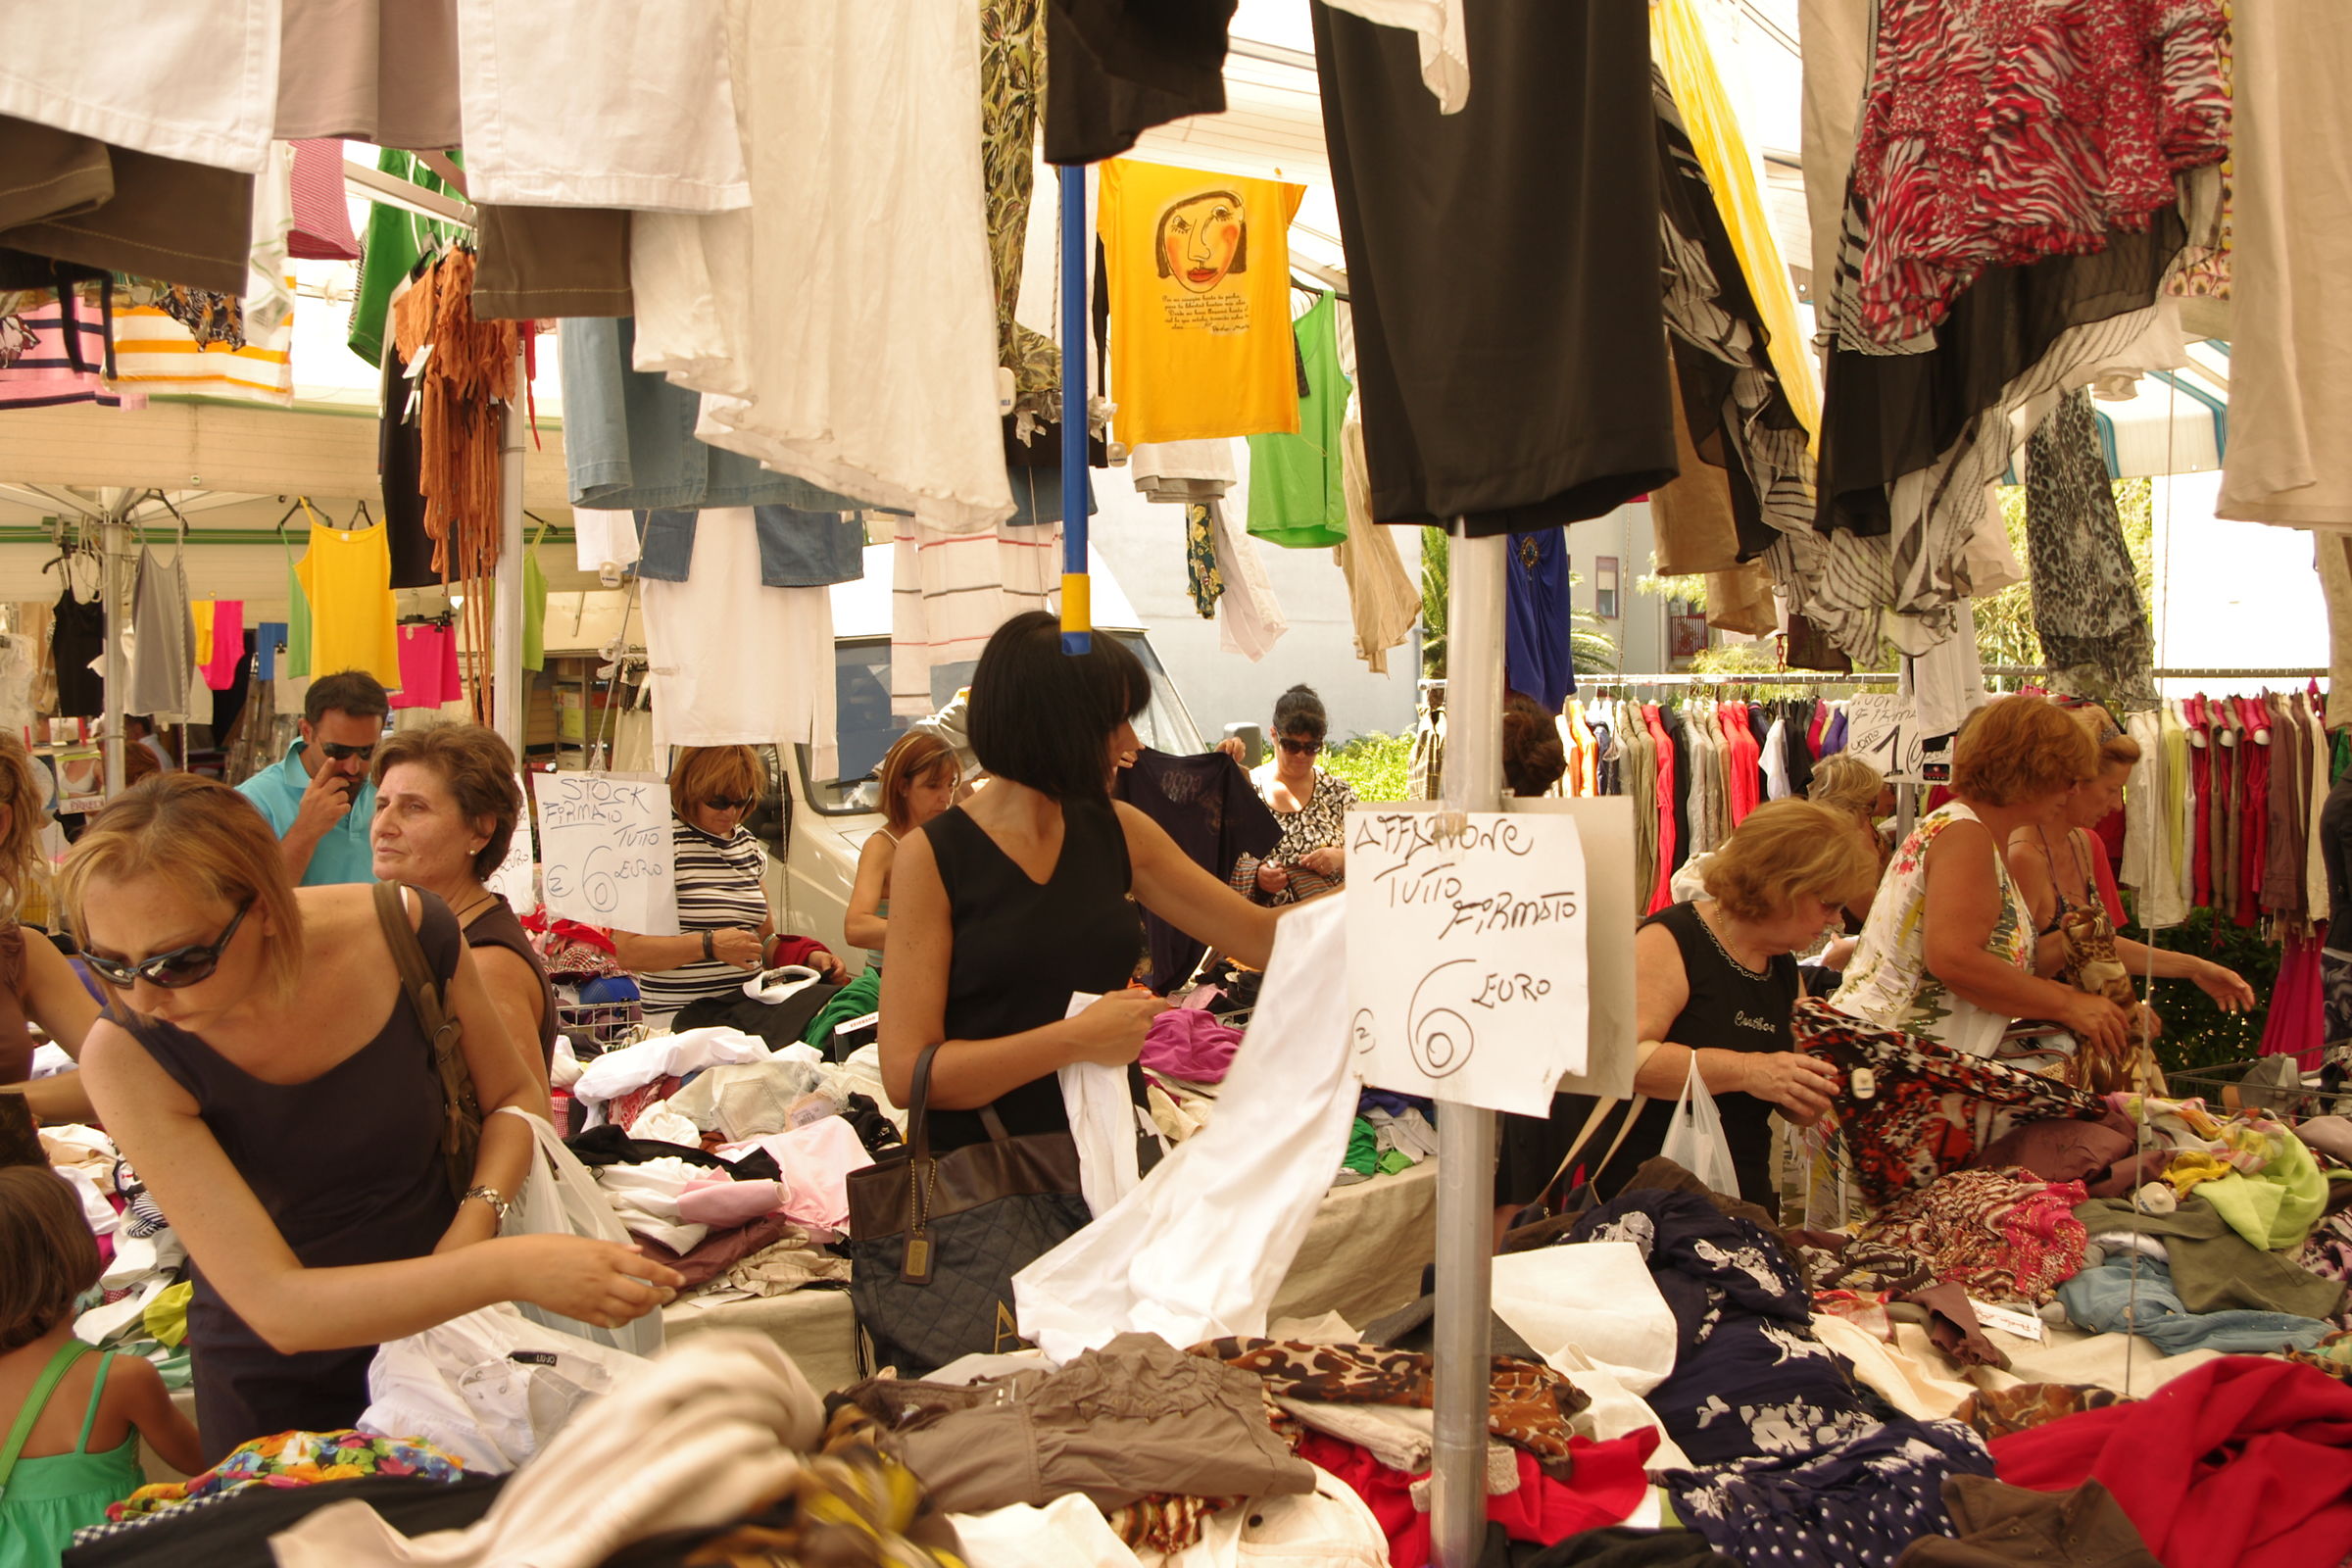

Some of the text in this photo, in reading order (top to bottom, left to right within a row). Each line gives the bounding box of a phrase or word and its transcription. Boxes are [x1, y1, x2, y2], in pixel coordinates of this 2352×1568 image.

[542, 800, 623, 825] FIRMATO
[560, 778, 651, 814] STOCK
[612, 822, 662, 849] TUTTO
[581, 845, 619, 913] 6
[613, 858, 663, 880] EURO
[1373, 862, 1462, 908] TUTTO
[1438, 891, 1577, 940] FIRMATO
[1407, 958, 1477, 1079] 6
[1470, 973, 1551, 1009] EURO
